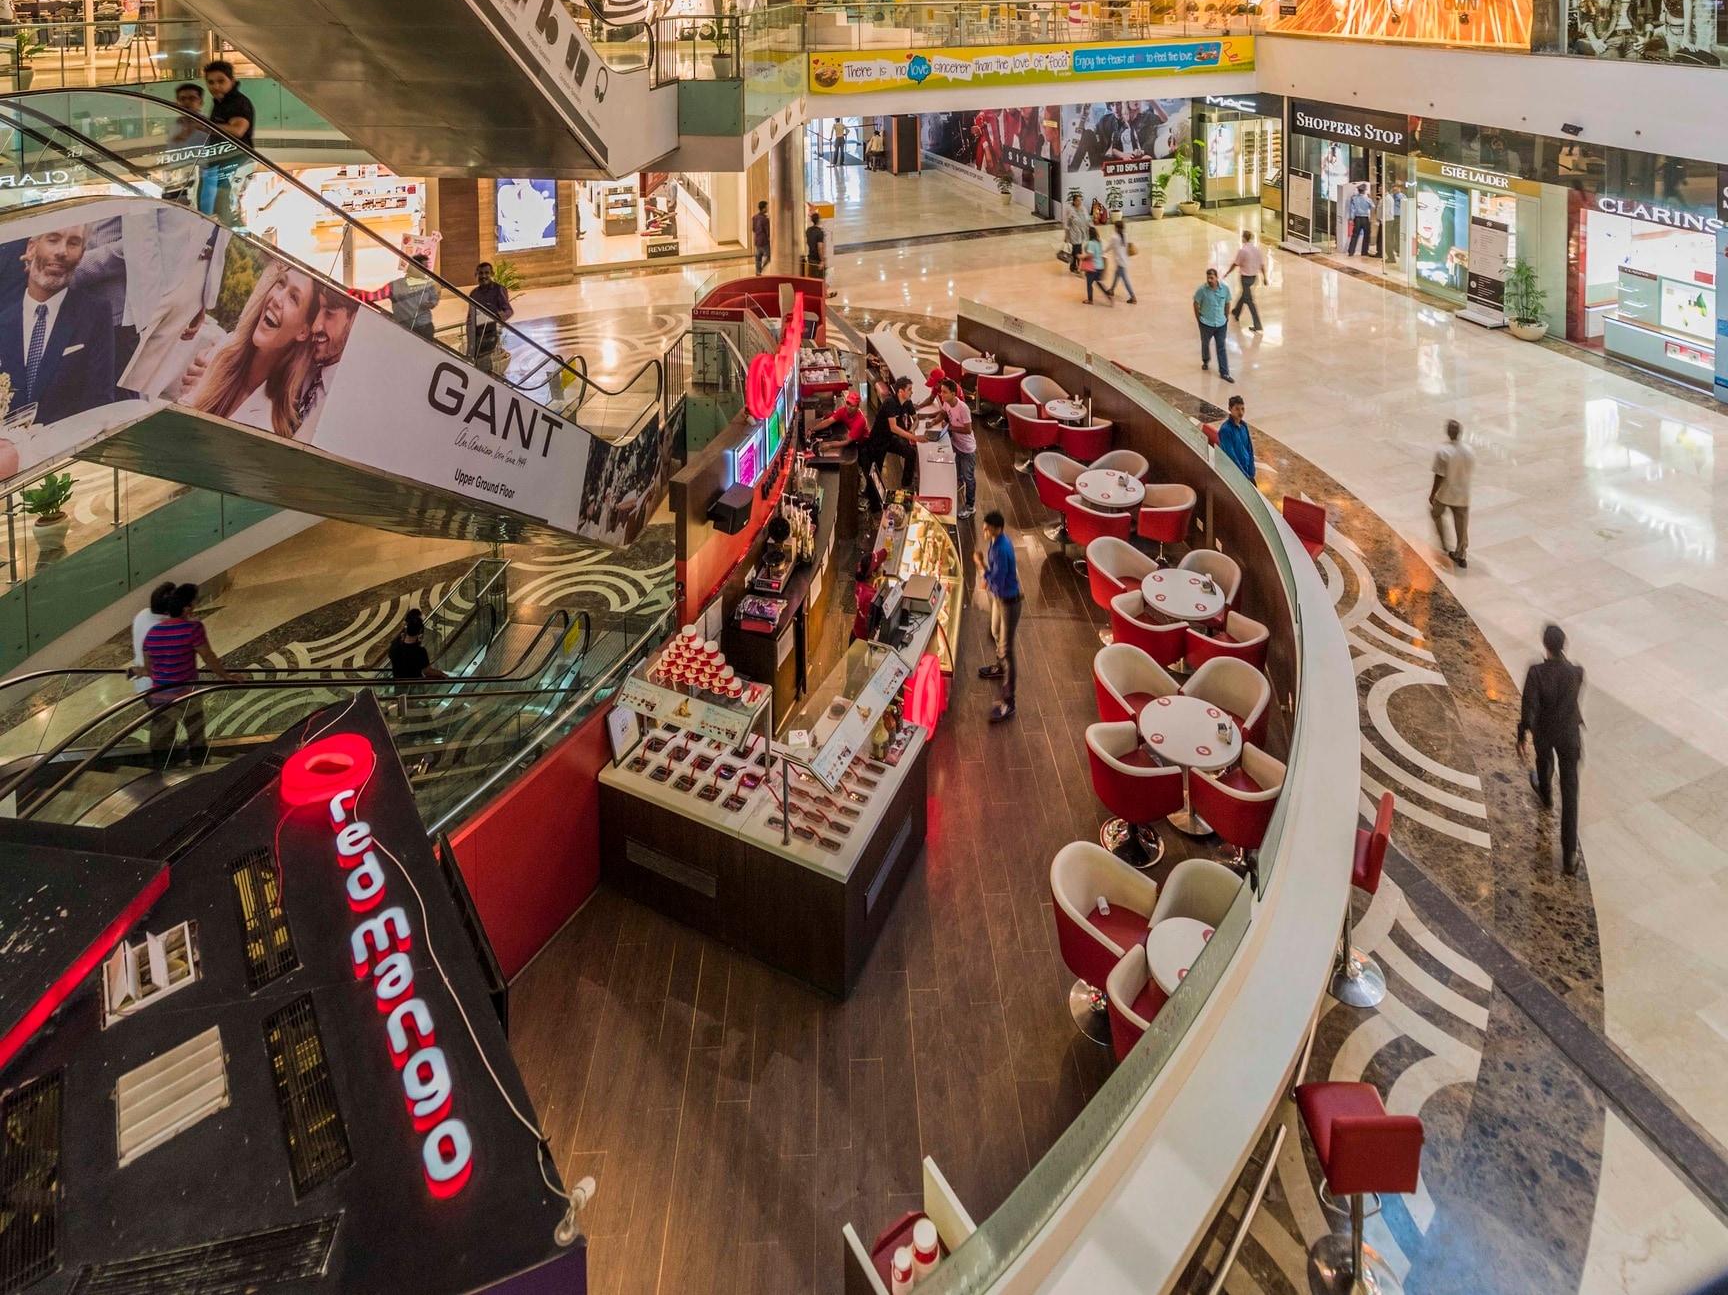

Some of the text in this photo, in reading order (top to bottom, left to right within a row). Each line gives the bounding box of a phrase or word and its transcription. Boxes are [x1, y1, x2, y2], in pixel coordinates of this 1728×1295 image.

[844, 53, 1069, 78] There is no love sincerer than the love of food
[1074, 55, 1095, 70] Enjoy
[1095, 54, 1107, 66] the
[1106, 53, 1127, 66] feast
[1127, 53, 1136, 64] at
[1153, 51, 1168, 63] feel
[1168, 50, 1179, 62] the
[1179, 50, 1193, 61] love
[1296, 110, 1404, 146] SHOPPERS STOP
[1106, 161, 1150, 174] UP TO 50% OFF
[1469, 171, 1510, 188] LAUDER
[1105, 179, 1113, 187] ON
[1113, 177, 1126, 186] 100%
[1598, 197, 1725, 234] CLARINS
[647, 245, 676, 254] REVLON
[427, 361, 564, 458] GANT
[454, 467, 516, 499] Upper Ground Floor
[329, 788, 473, 1196] red mango
